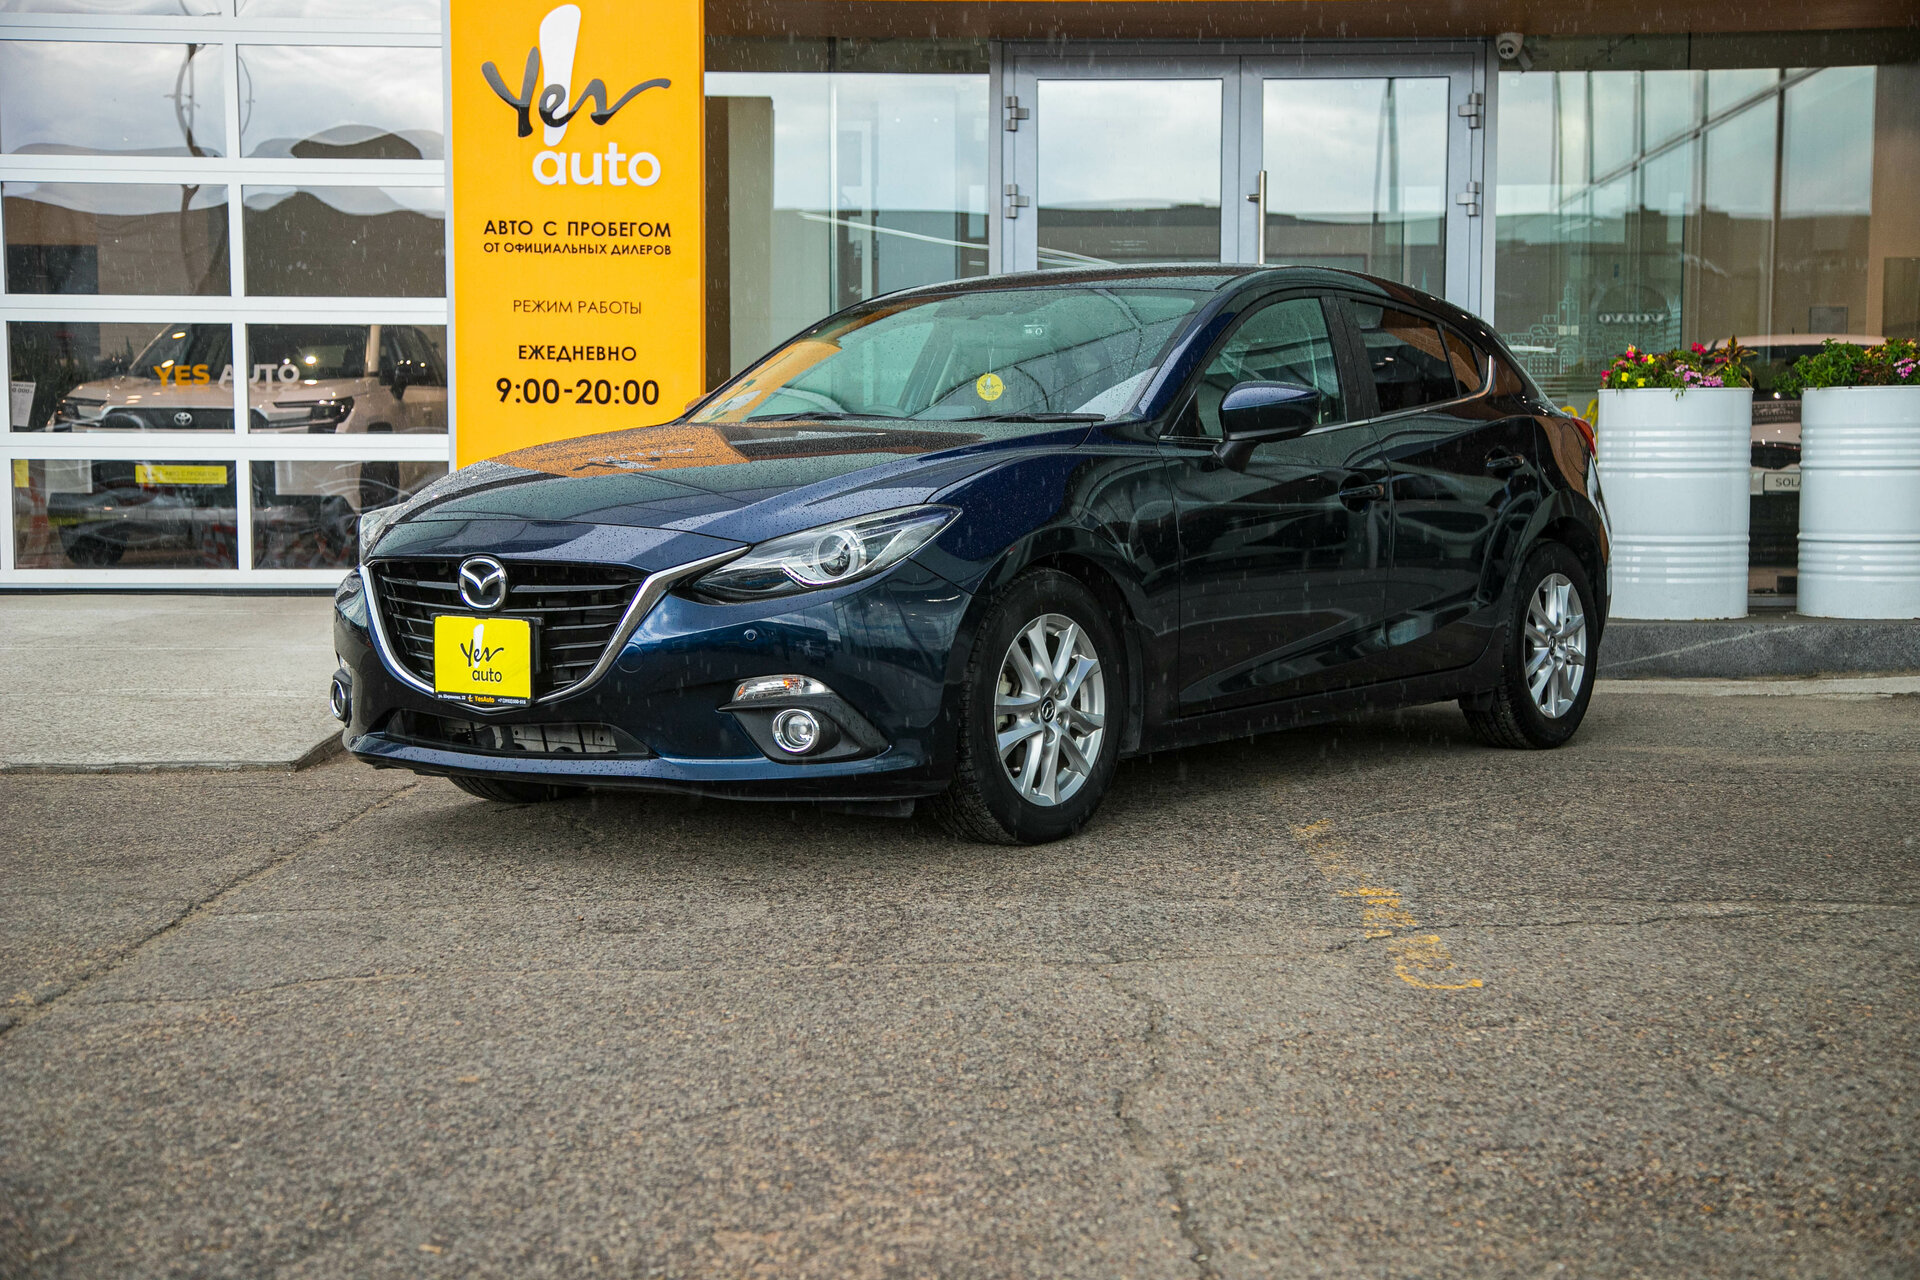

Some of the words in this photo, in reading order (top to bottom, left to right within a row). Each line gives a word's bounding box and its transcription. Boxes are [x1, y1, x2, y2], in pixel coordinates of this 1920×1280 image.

[481, 46, 671, 137] Yes
[532, 142, 661, 186] auto
[483, 220, 533, 236] АВТО
[543, 221, 557, 236] С
[567, 222, 671, 237] ПРОБЕГОМ
[483, 242, 500, 253] ОТ
[503, 242, 607, 255] ОФИЦИАЛЬНЫХ
[611, 244, 671, 255] ДИЛЕРОВ
[513, 299, 573, 313] РЕЖИМ
[577, 301, 642, 314] РАБОТЫ
[518, 345, 636, 362] ЕЖЕДНЕВНО
[153, 364, 210, 386] YES
[496, 378, 659, 405] 9:00-20:00
[460, 639, 504, 667] Yes
[472, 668, 502, 682] auto
